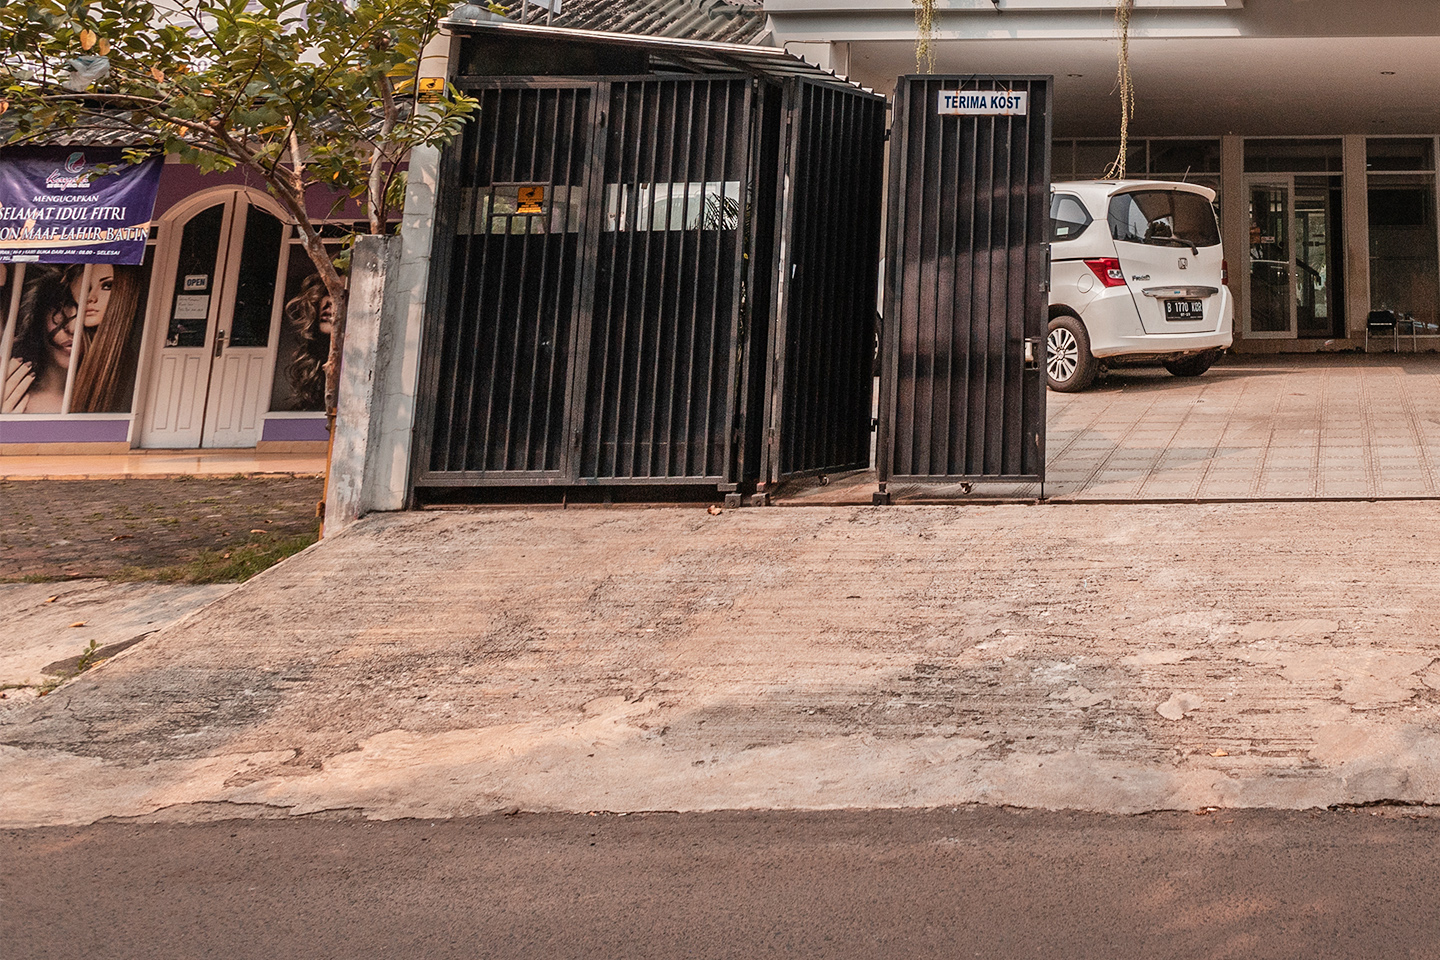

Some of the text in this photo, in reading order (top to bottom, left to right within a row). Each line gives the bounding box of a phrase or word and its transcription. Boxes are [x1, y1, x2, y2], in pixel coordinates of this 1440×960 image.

[944, 95, 1021, 109] TERIMA KOST
[0, 207, 127, 220] SELAMAT IDUL FITRI
[0, 227, 148, 241] ON MAAF LAHIR BATIN
[187, 279, 206, 287] OPEN
[1167, 302, 1173, 313] B
[1174, 302, 1189, 313] 1770
